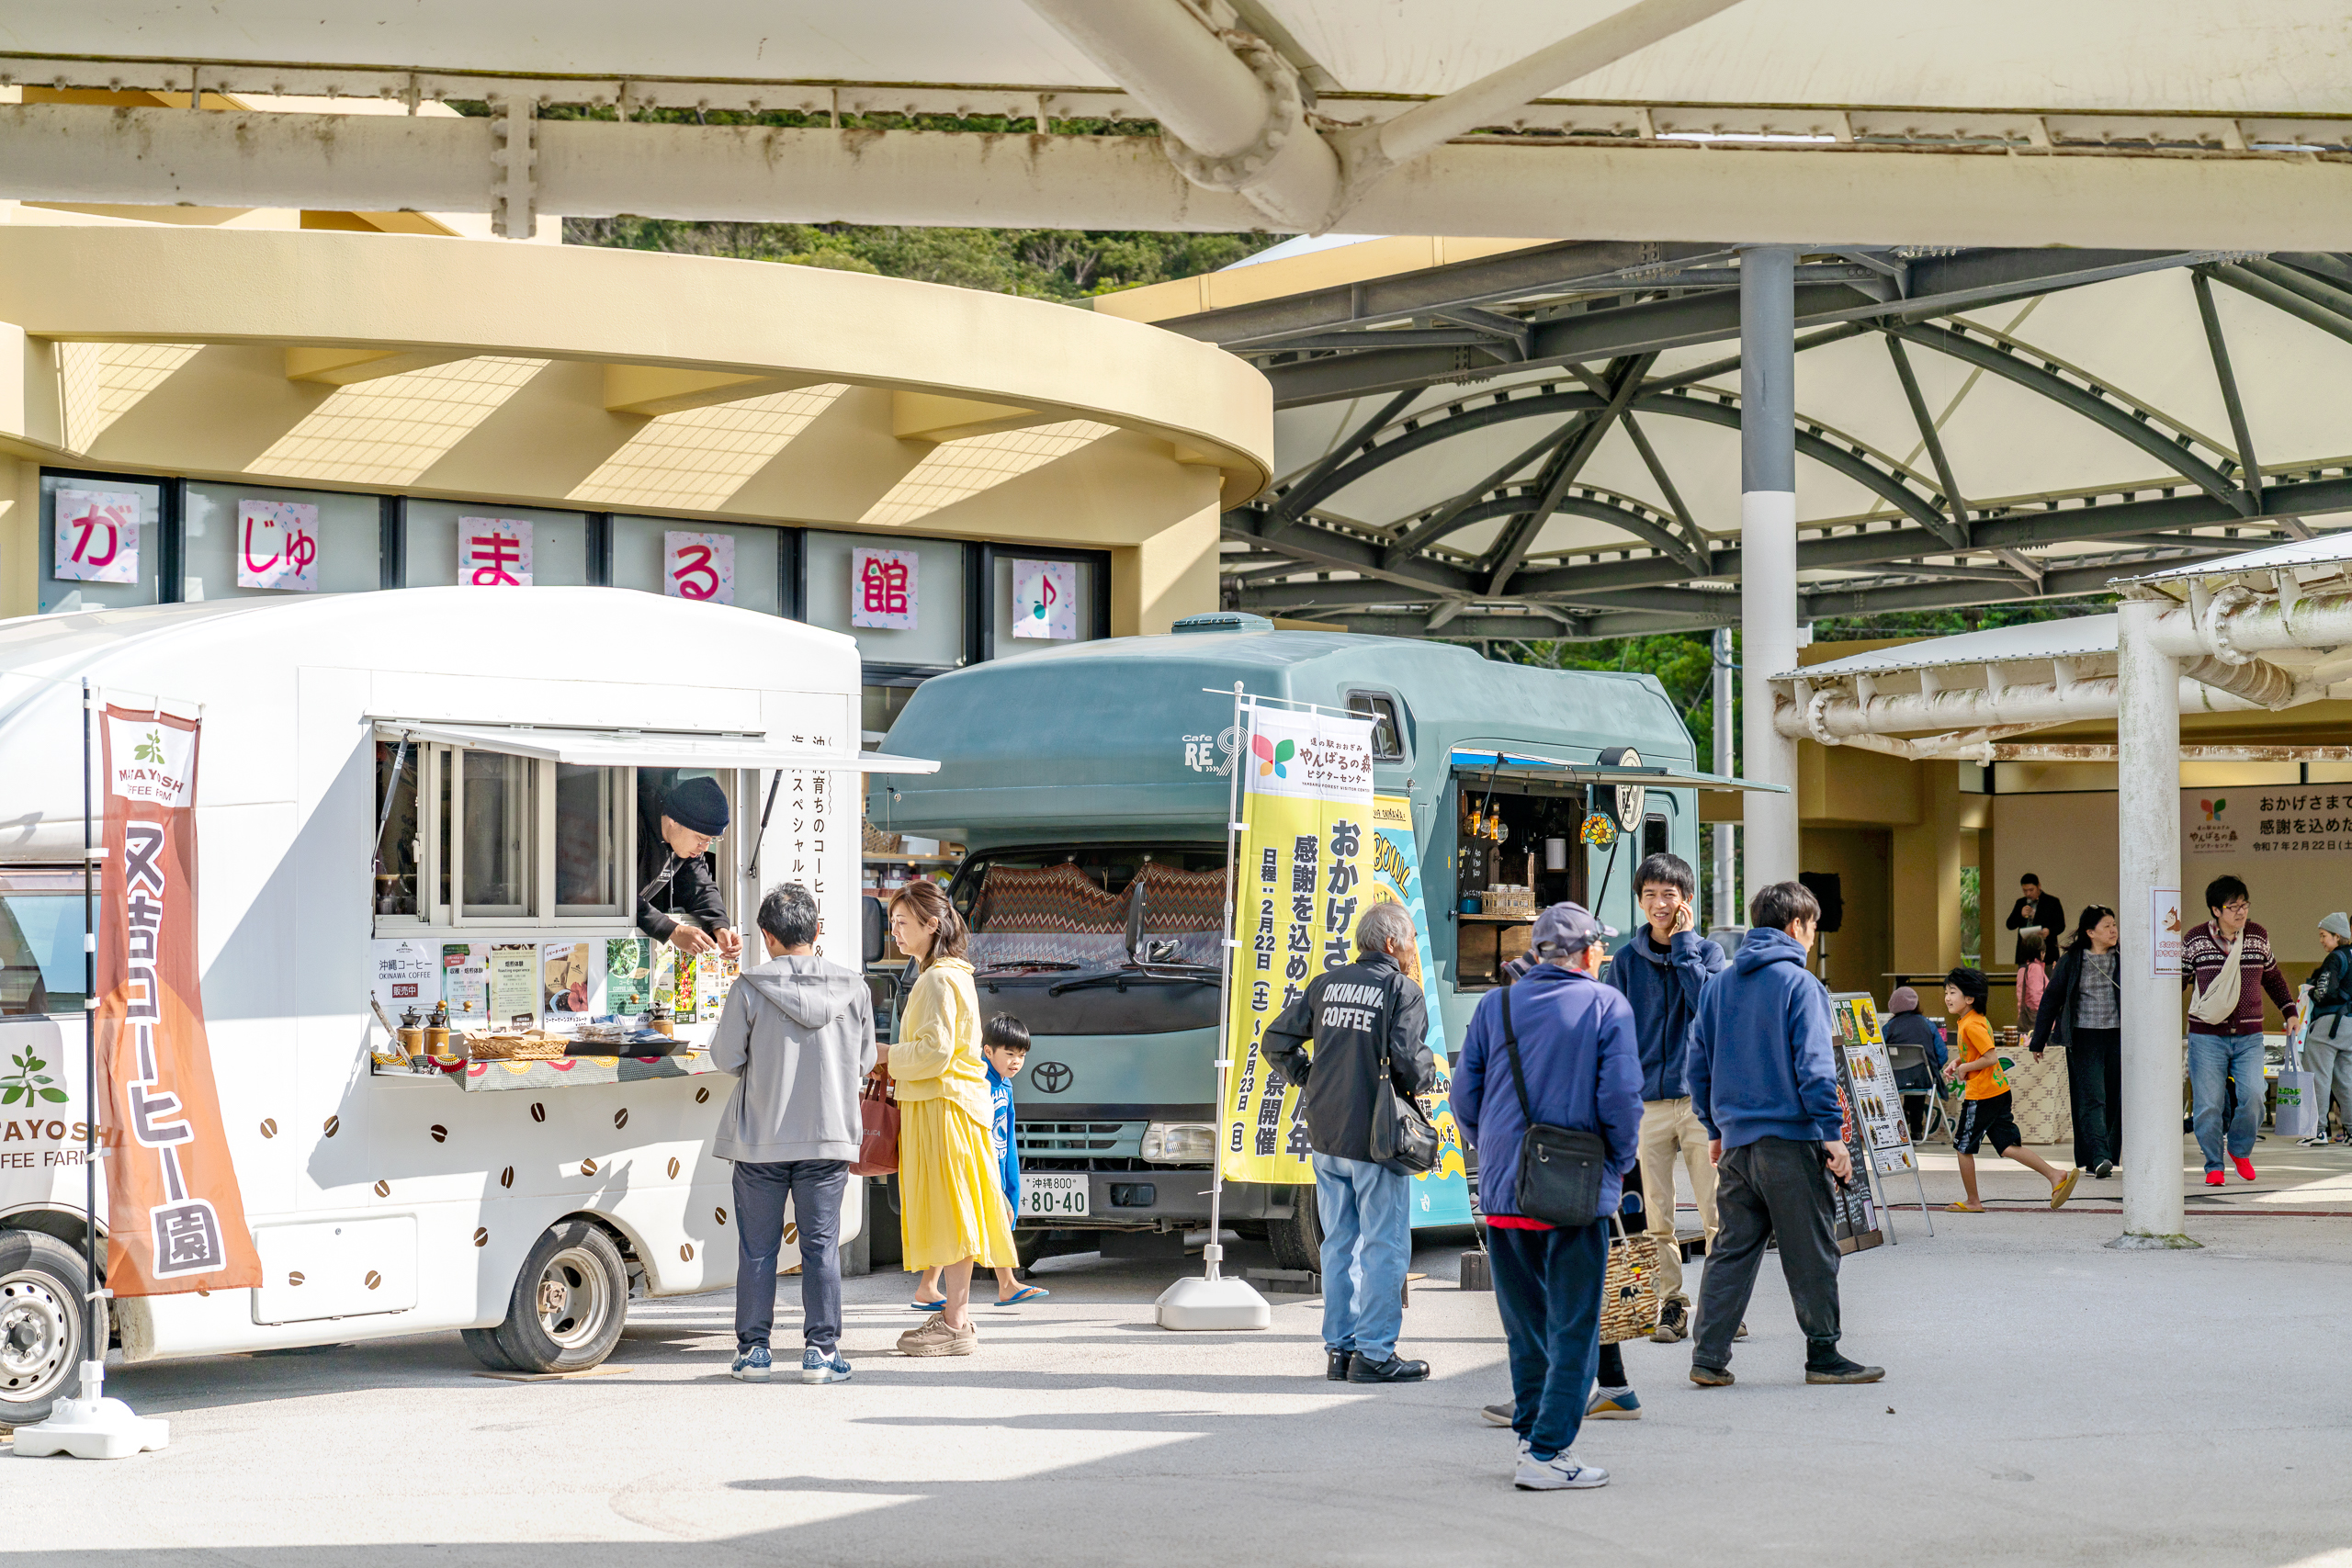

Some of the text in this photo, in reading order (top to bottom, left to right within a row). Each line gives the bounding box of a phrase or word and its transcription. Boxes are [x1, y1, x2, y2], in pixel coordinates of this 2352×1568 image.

[72, 503, 908, 614] が じゅ ま る 館
[1182, 734, 1213, 742] Cafe
[1310, 738, 1363, 751] 道の駅おおぎみ
[1184, 743, 1214, 773] RE
[1299, 748, 1372, 773] やんばるの森
[1307, 770, 1366, 784] ビジターセンター
[2260, 818, 2352, 835] 感謝を込めた
[379, 959, 433, 971] 沖縄コーヒー
[379, 971, 431, 980] OKINAWA COFFEE
[393, 986, 416, 996] 販売中
[1322, 983, 1384, 1009] OKINAWA
[1321, 1007, 1376, 1033] COFFEE
[1032, 1191, 1085, 1213] 80-40
